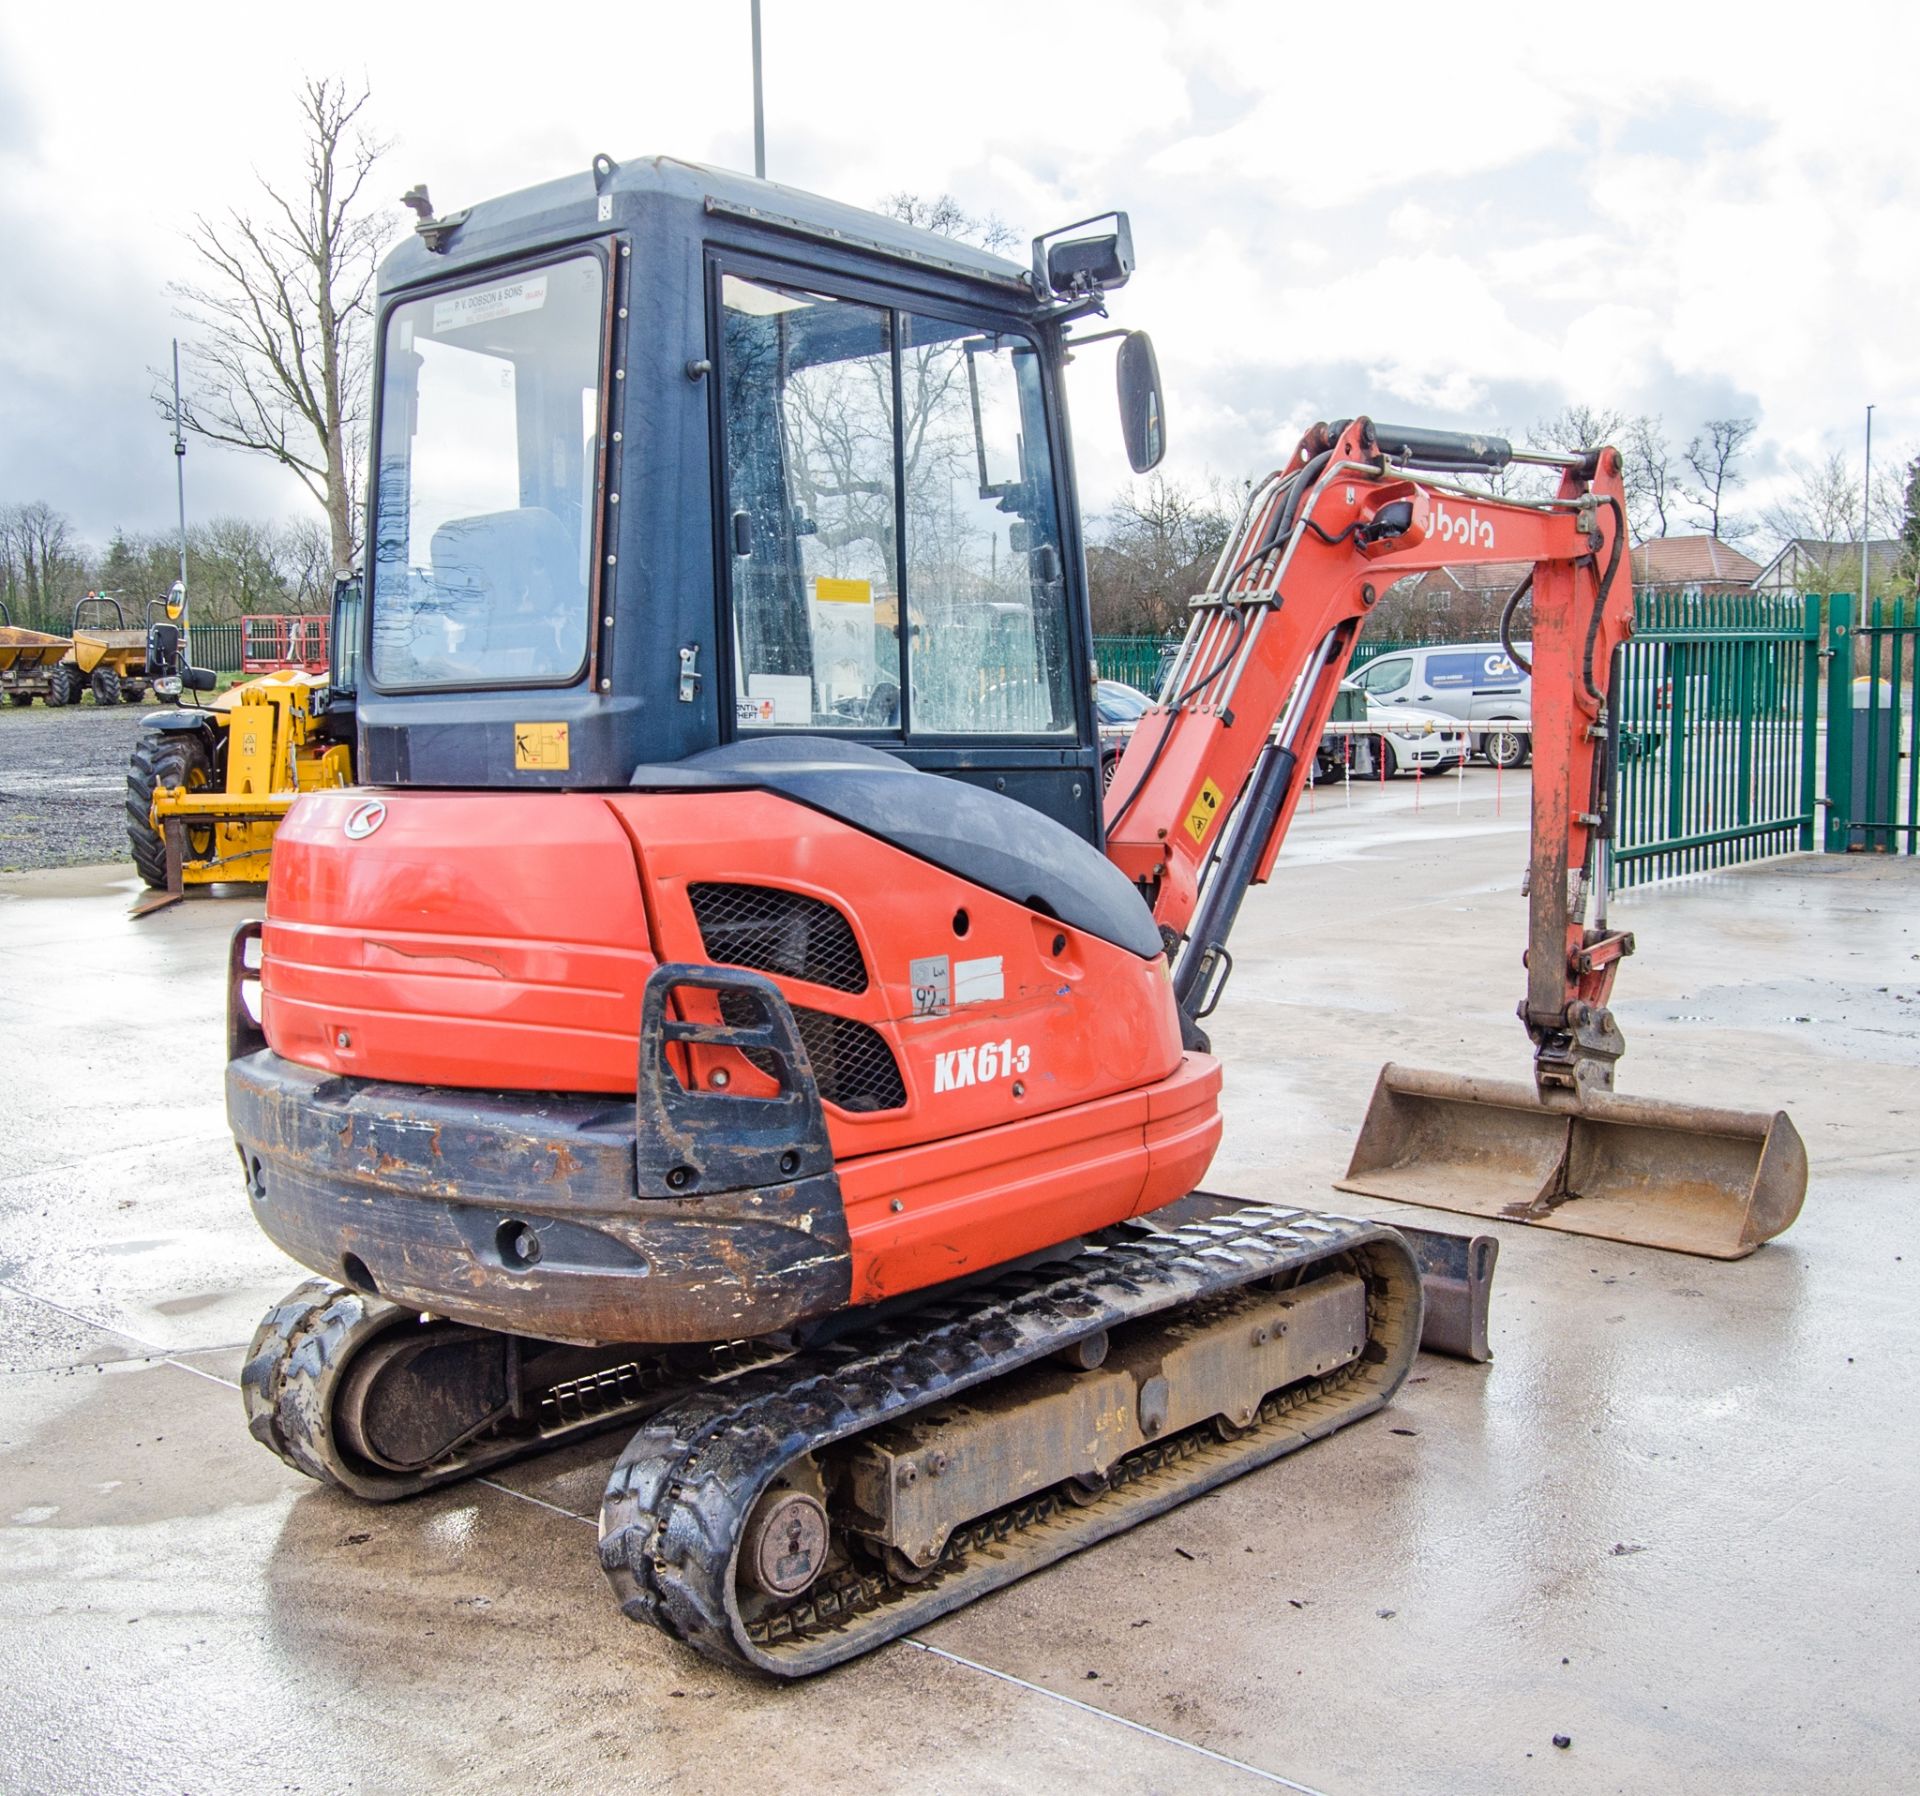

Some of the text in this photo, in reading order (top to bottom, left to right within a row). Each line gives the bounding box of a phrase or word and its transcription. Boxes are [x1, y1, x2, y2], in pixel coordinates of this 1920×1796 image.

[468, 291, 497, 308] DOBSON
[504, 285, 523, 299] SONS
[933, 1038, 1031, 1094] KX61-3
